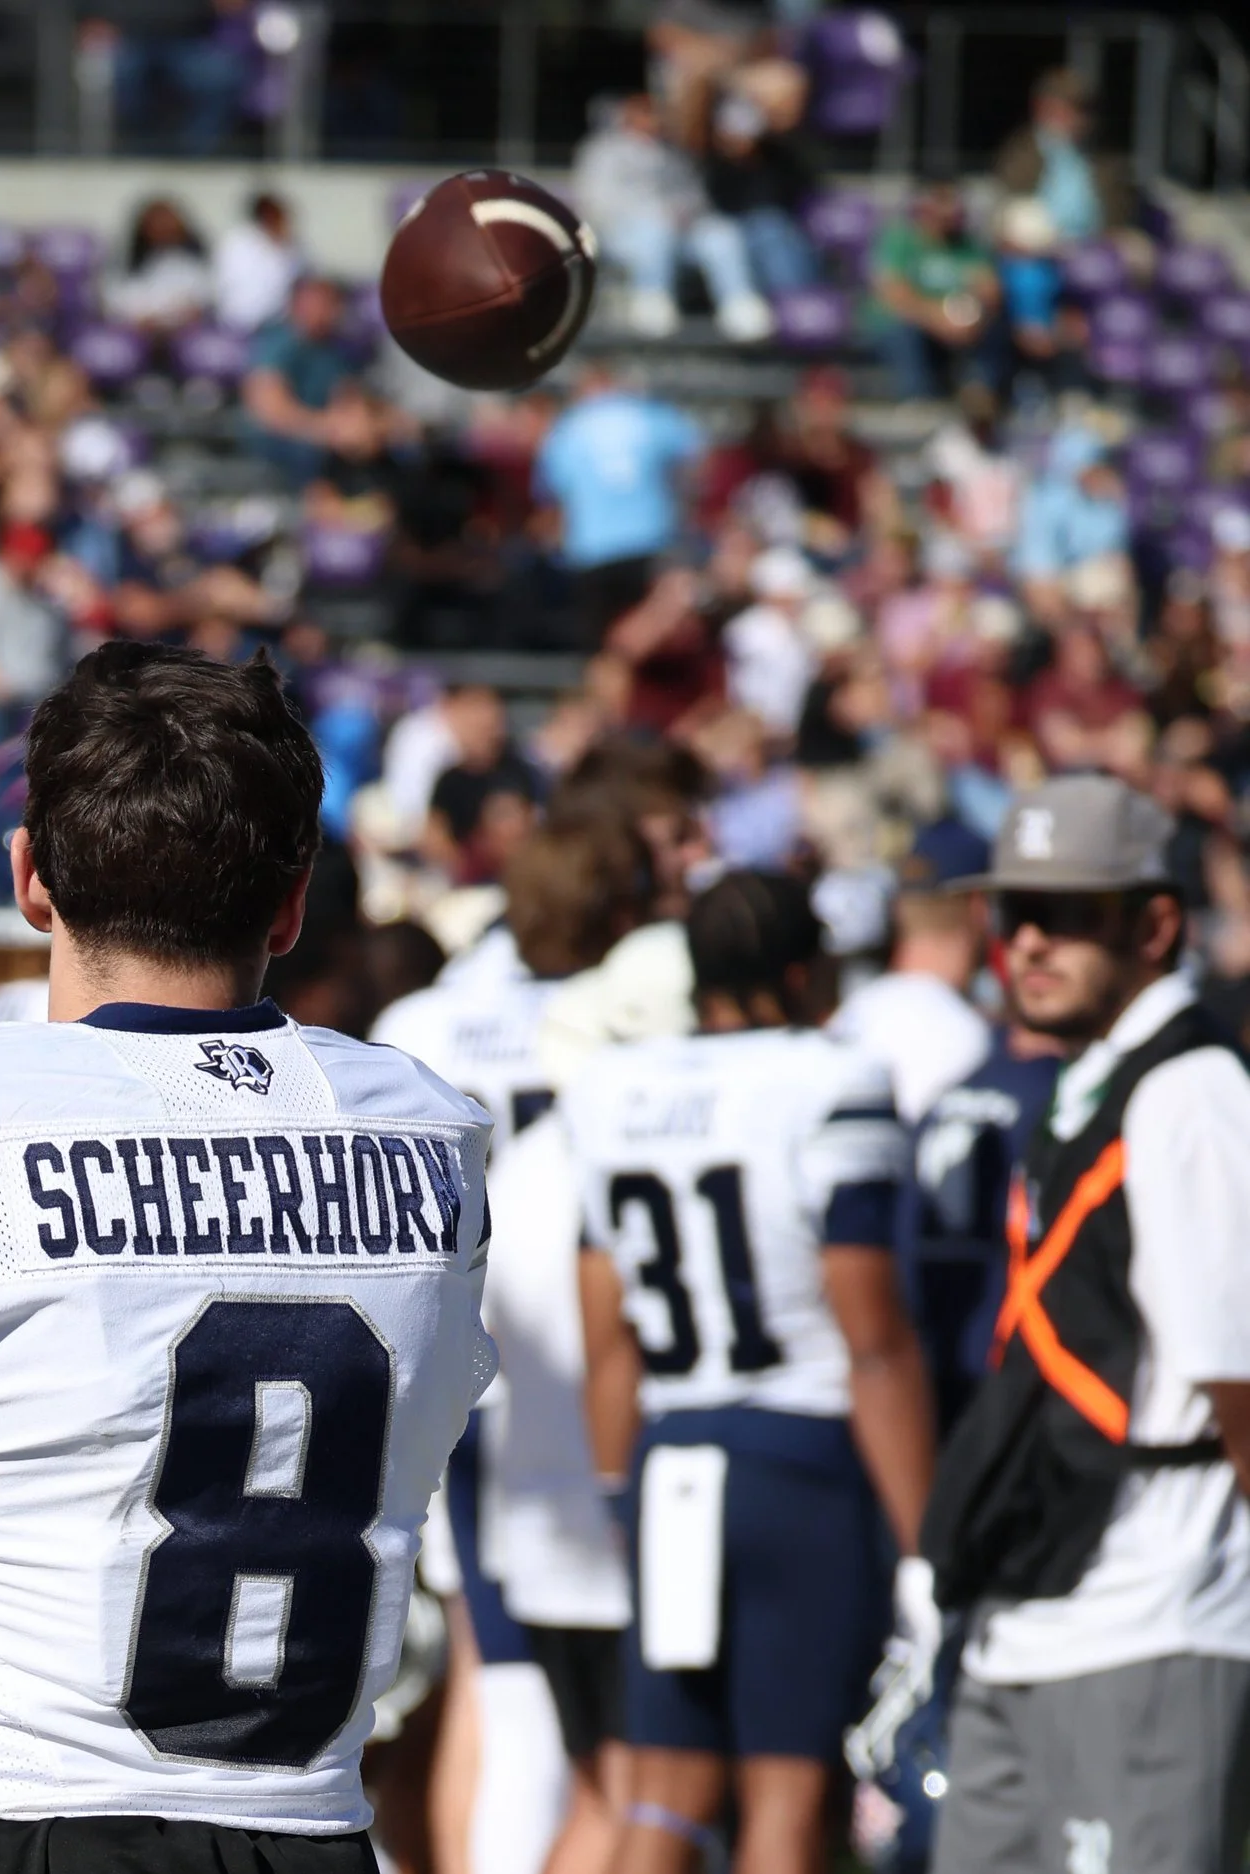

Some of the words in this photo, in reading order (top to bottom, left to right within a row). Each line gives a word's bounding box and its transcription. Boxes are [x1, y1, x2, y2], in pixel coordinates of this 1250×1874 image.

[23, 1134, 461, 1259] SCHEERHORN
[607, 1162, 790, 1377] 31
[119, 1292, 397, 1775] 8
